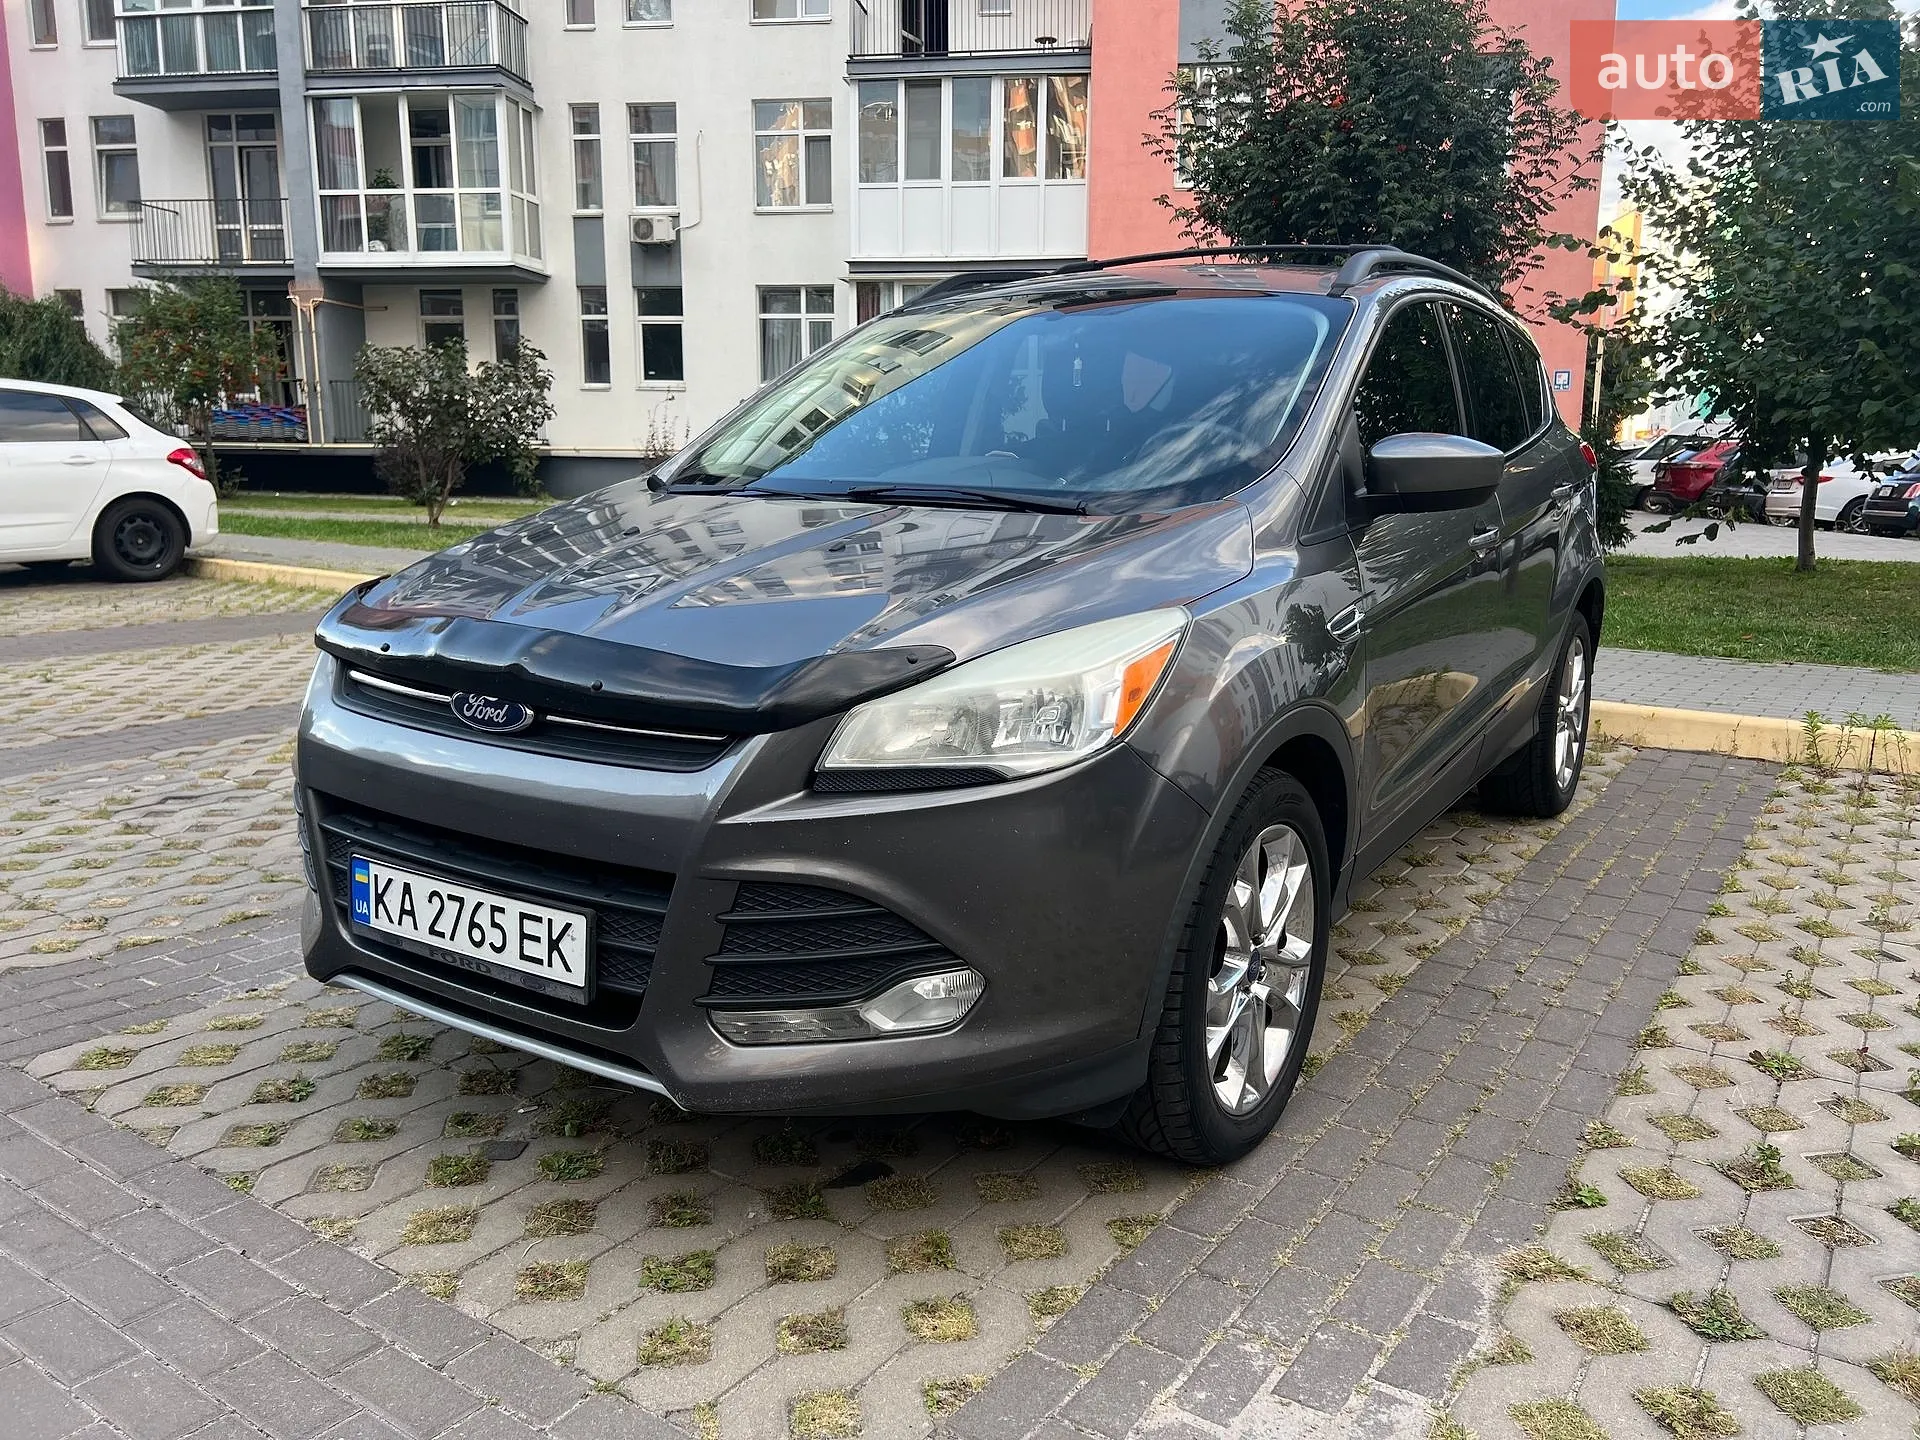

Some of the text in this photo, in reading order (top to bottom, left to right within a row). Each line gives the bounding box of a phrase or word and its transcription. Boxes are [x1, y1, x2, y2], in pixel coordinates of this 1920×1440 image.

[463, 694, 509, 723] Ford
[355, 898, 369, 916] UA
[373, 873, 573, 973] KA 2765 EK
[429, 949, 492, 974] FORD
